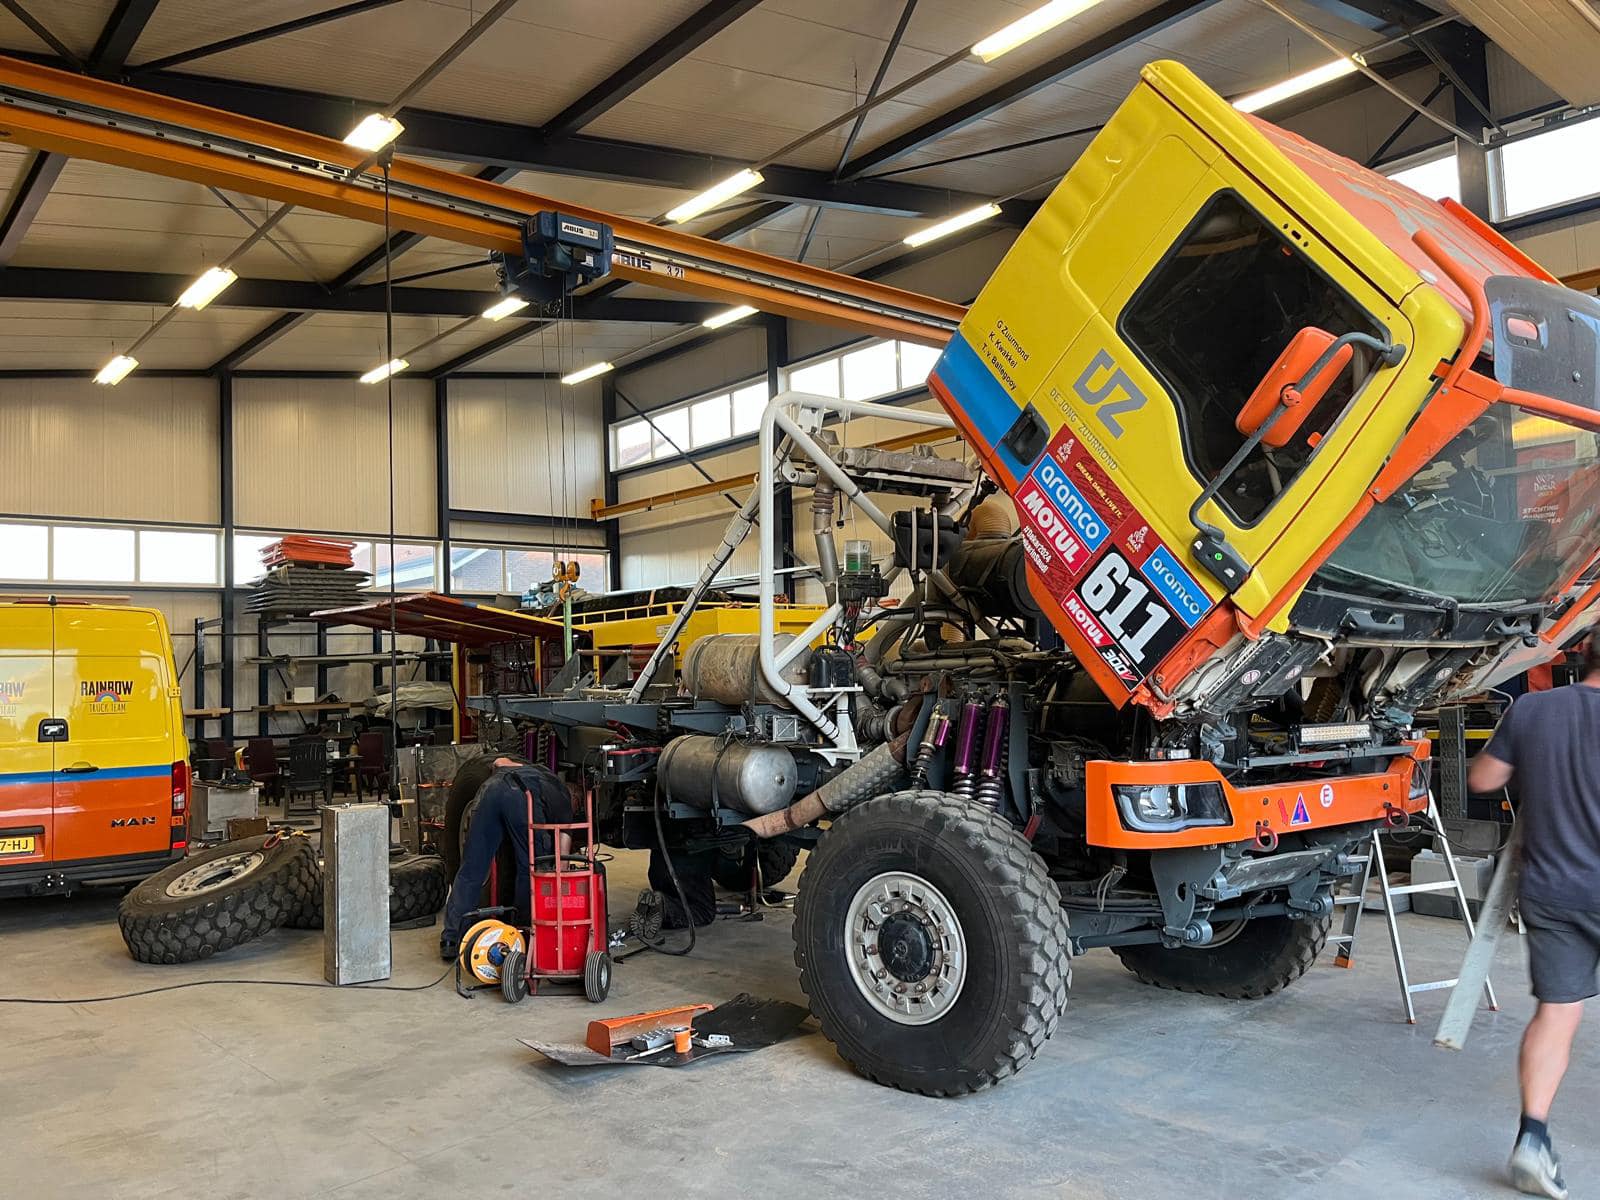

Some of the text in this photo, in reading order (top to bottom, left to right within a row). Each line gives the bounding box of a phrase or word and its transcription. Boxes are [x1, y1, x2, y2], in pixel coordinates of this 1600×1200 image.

[563, 224, 584, 234] ABUS
[613, 253, 652, 271] BUS
[993, 339, 1018, 369] Kwakkel
[1000, 326, 1030, 362] Zuurmond
[1050, 388, 1060, 402] DE
[1057, 397, 1078, 423] JONG
[1078, 423, 1118, 471] ZUURMOND
[1041, 465, 1100, 539] aramco
[1022, 490, 1080, 563] MOTUL
[1151, 557, 1200, 615] aramco
[1066, 597, 1105, 645] MOTUL
[1081, 552, 1171, 664] 611
[1102, 649, 1139, 682] 300V
[81, 681, 133, 696] RAINBOW
[89, 703, 126, 713] TRUCK TEAM
[111, 816, 156, 828] MAN
